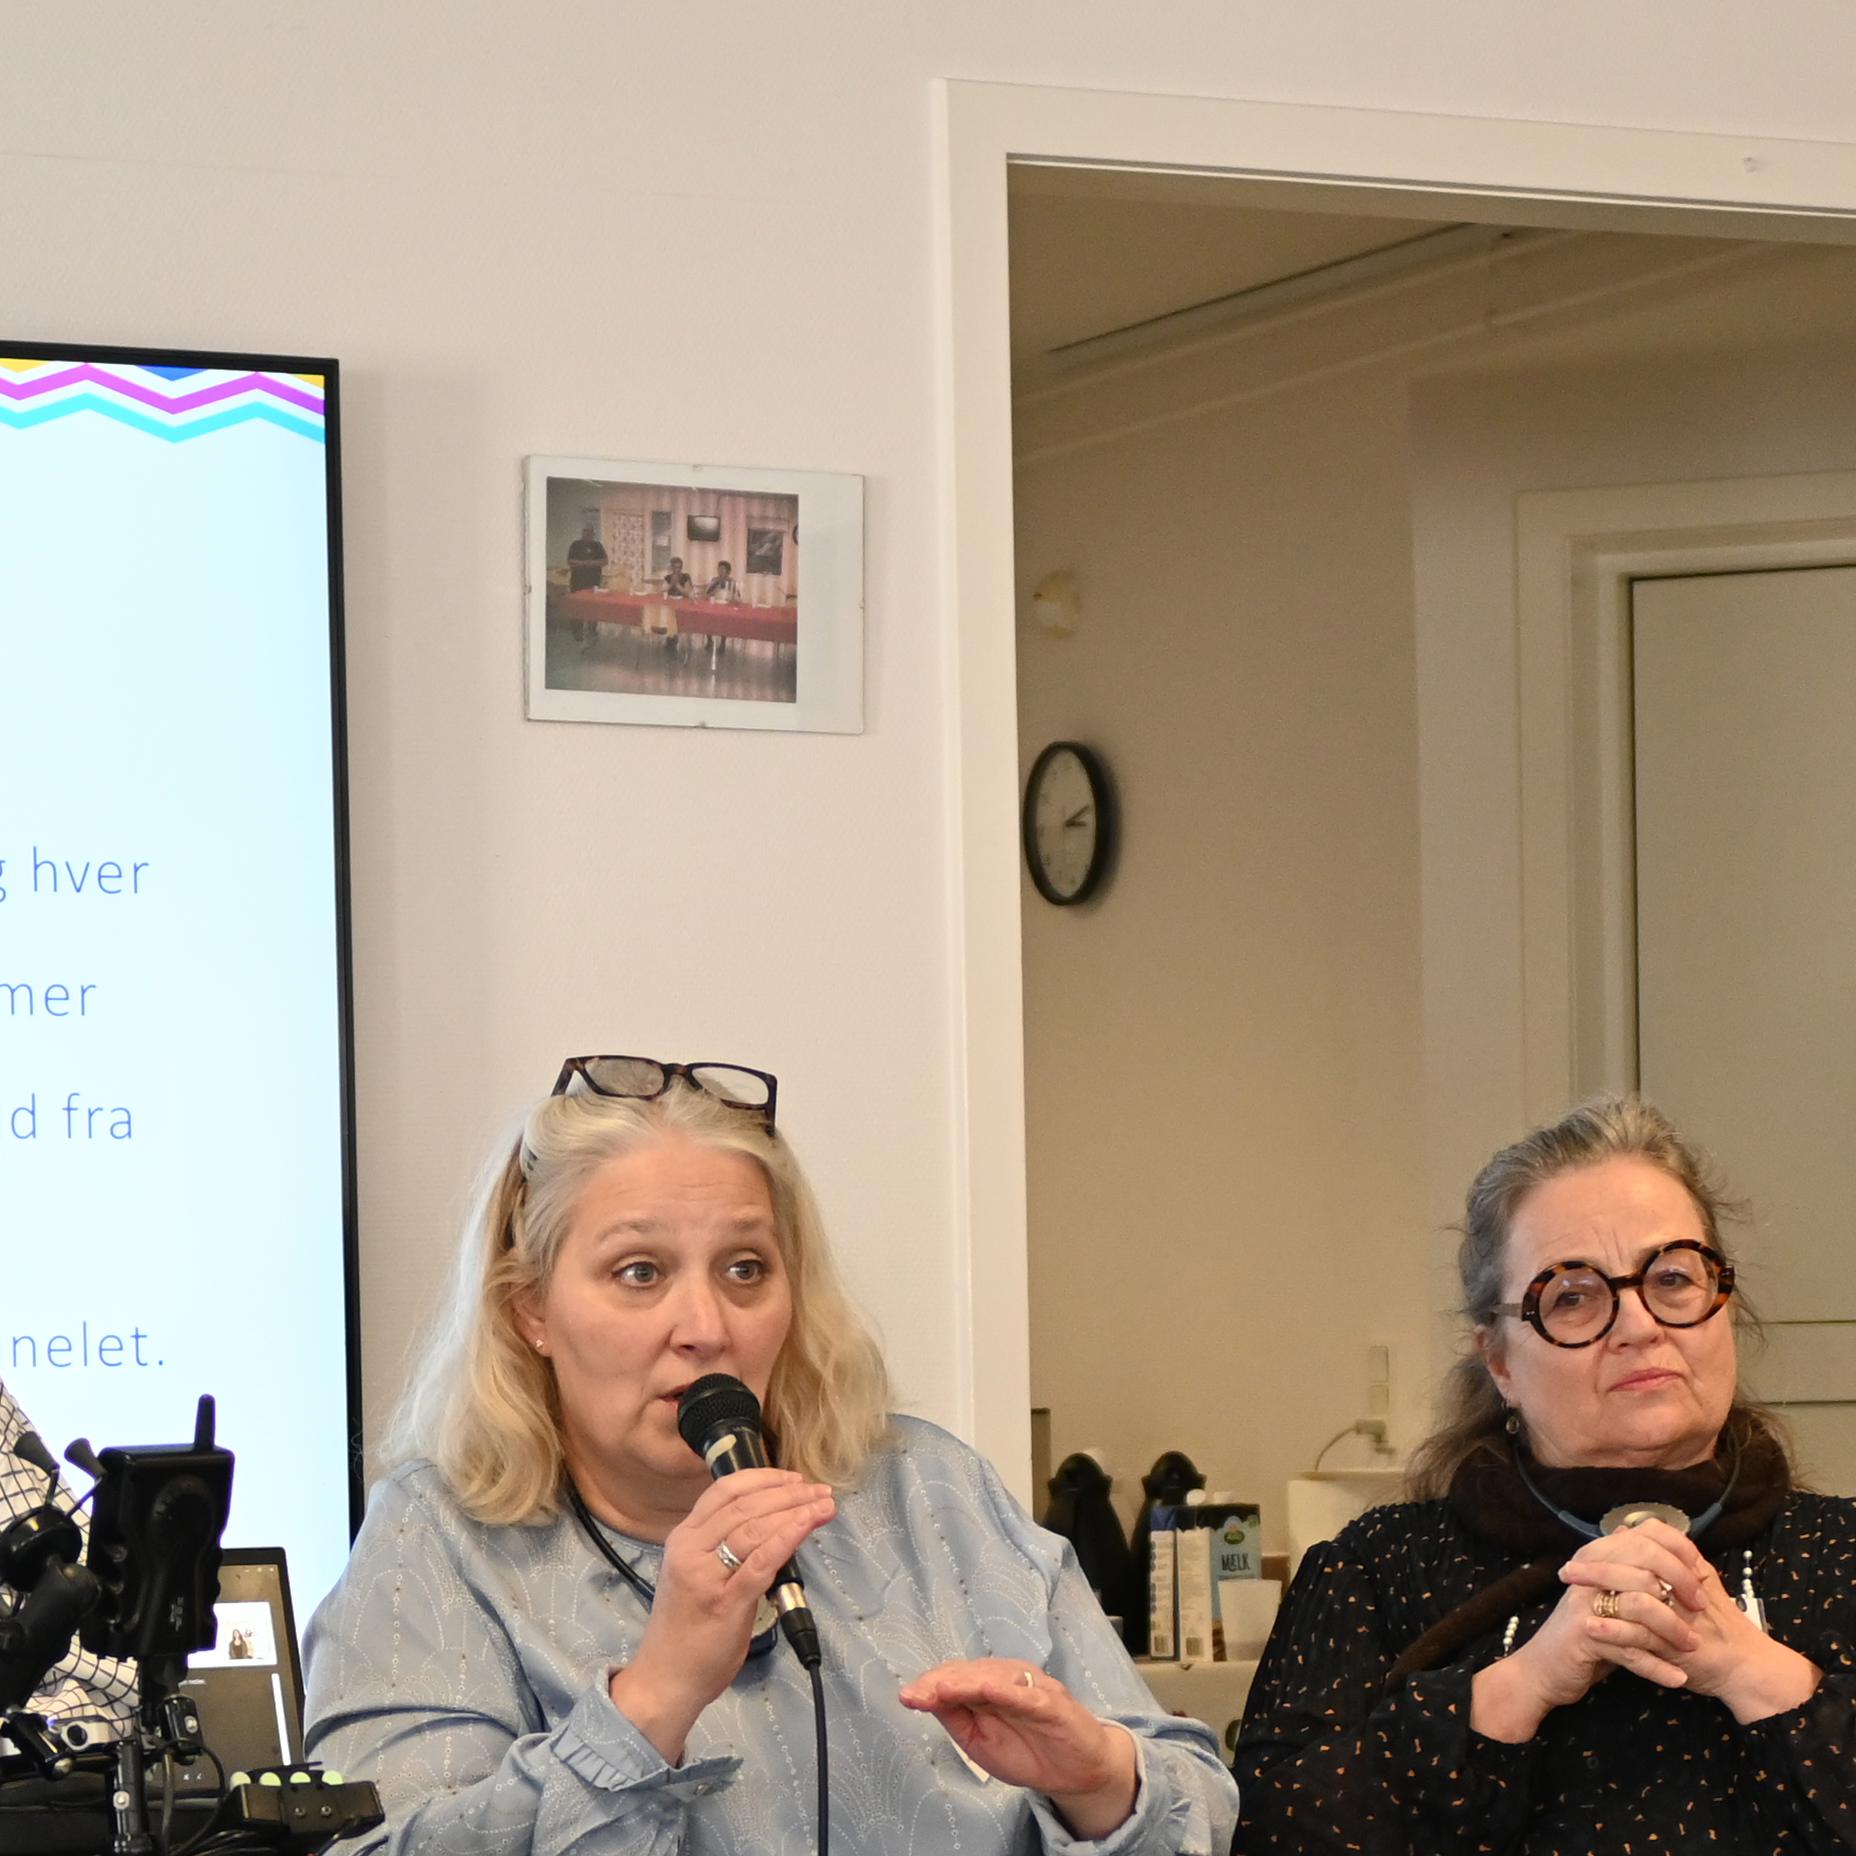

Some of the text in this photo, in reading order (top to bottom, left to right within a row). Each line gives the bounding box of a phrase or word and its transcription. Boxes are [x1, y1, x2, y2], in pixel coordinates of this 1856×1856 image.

[32, 844, 150, 895] hver
[61, 1092, 134, 1141] fra
[1221, 1552, 1251, 1572] MÆLK
